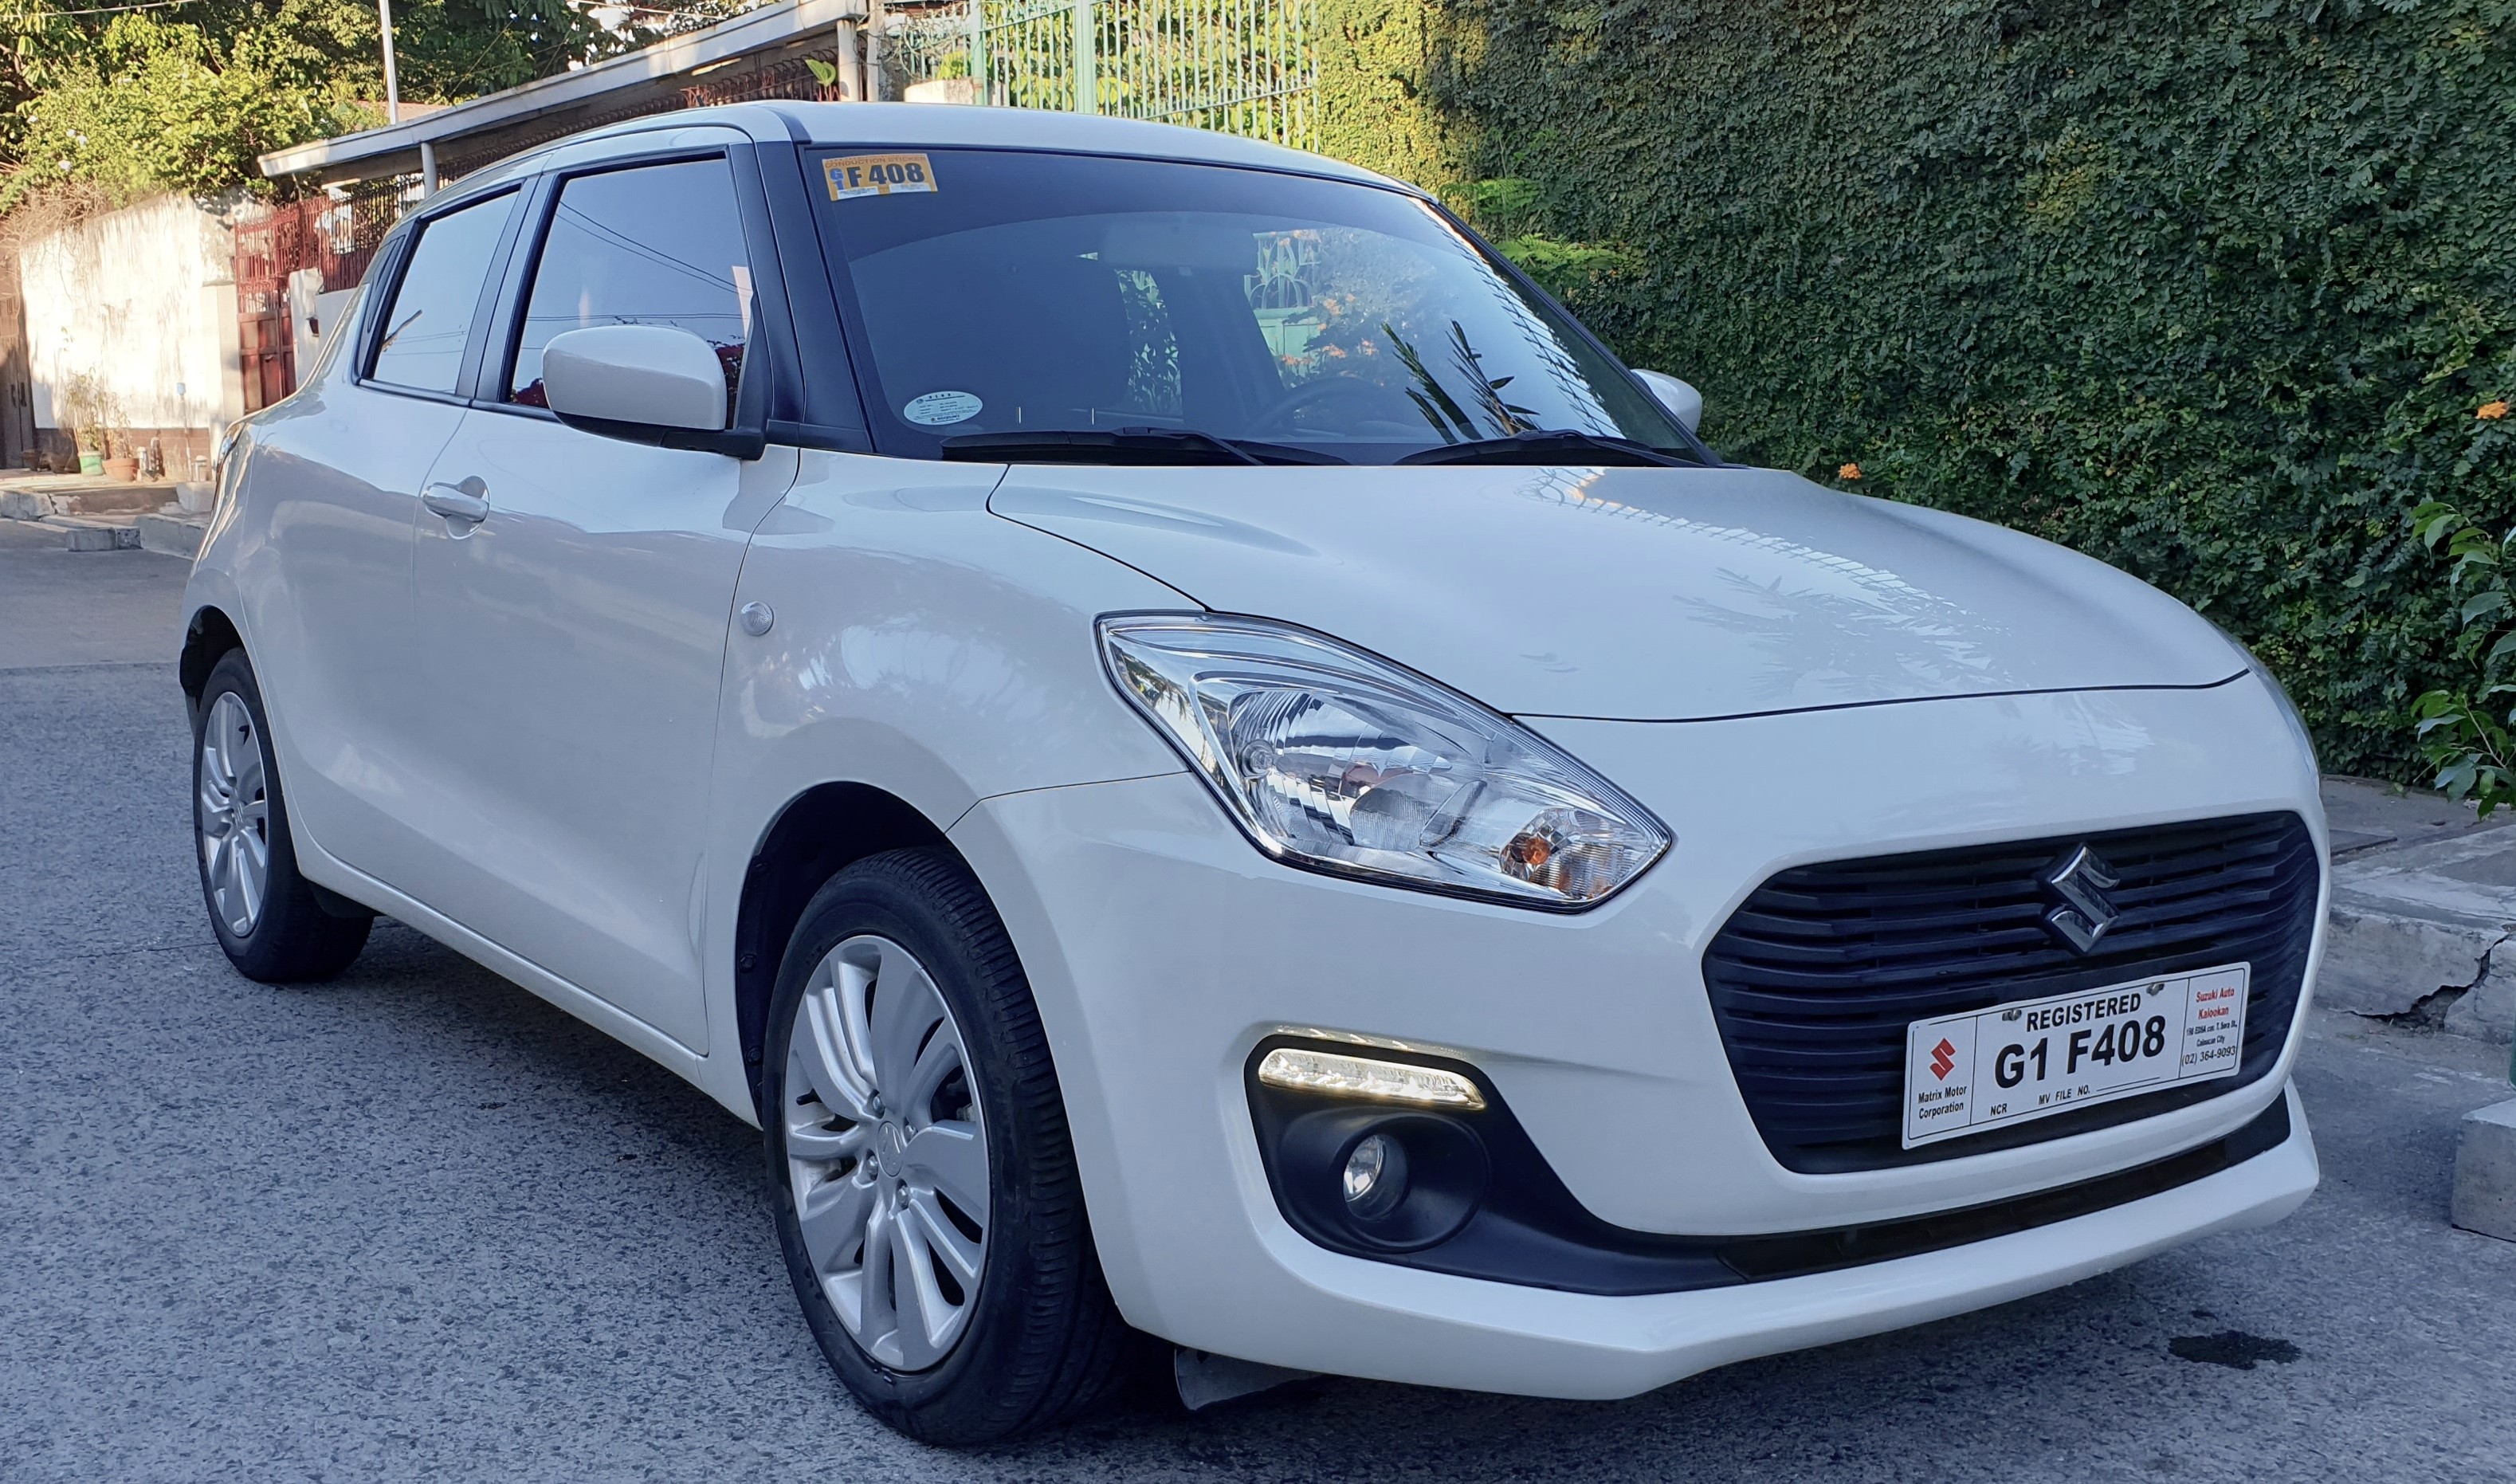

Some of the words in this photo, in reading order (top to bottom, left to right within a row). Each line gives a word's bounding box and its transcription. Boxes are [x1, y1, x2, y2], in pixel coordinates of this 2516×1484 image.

[846, 166, 862, 187] F
[869, 163, 925, 185] 408
[2196, 988, 2218, 1003] Suzuki
[2220, 987, 2235, 999] Auto
[2027, 993, 2141, 1032] REGISTERED
[2198, 1006, 2229, 1020] Kalookan
[1995, 1037, 2048, 1089] G1
[2067, 1015, 2166, 1075] F408
[2181, 1052, 2197, 1067] (02)
[2200, 1045, 2236, 1062] 364-9093
[1917, 1089, 1943, 1104] Matrix
[1945, 1086, 1968, 1098] Motor
[2038, 1093, 2051, 1105] MV
[2055, 1088, 2072, 1101] FILE
[2077, 1084, 2091, 1097] NO.
[1918, 1101, 1965, 1120] Corporation
[1990, 1102, 2008, 1117] NCR
